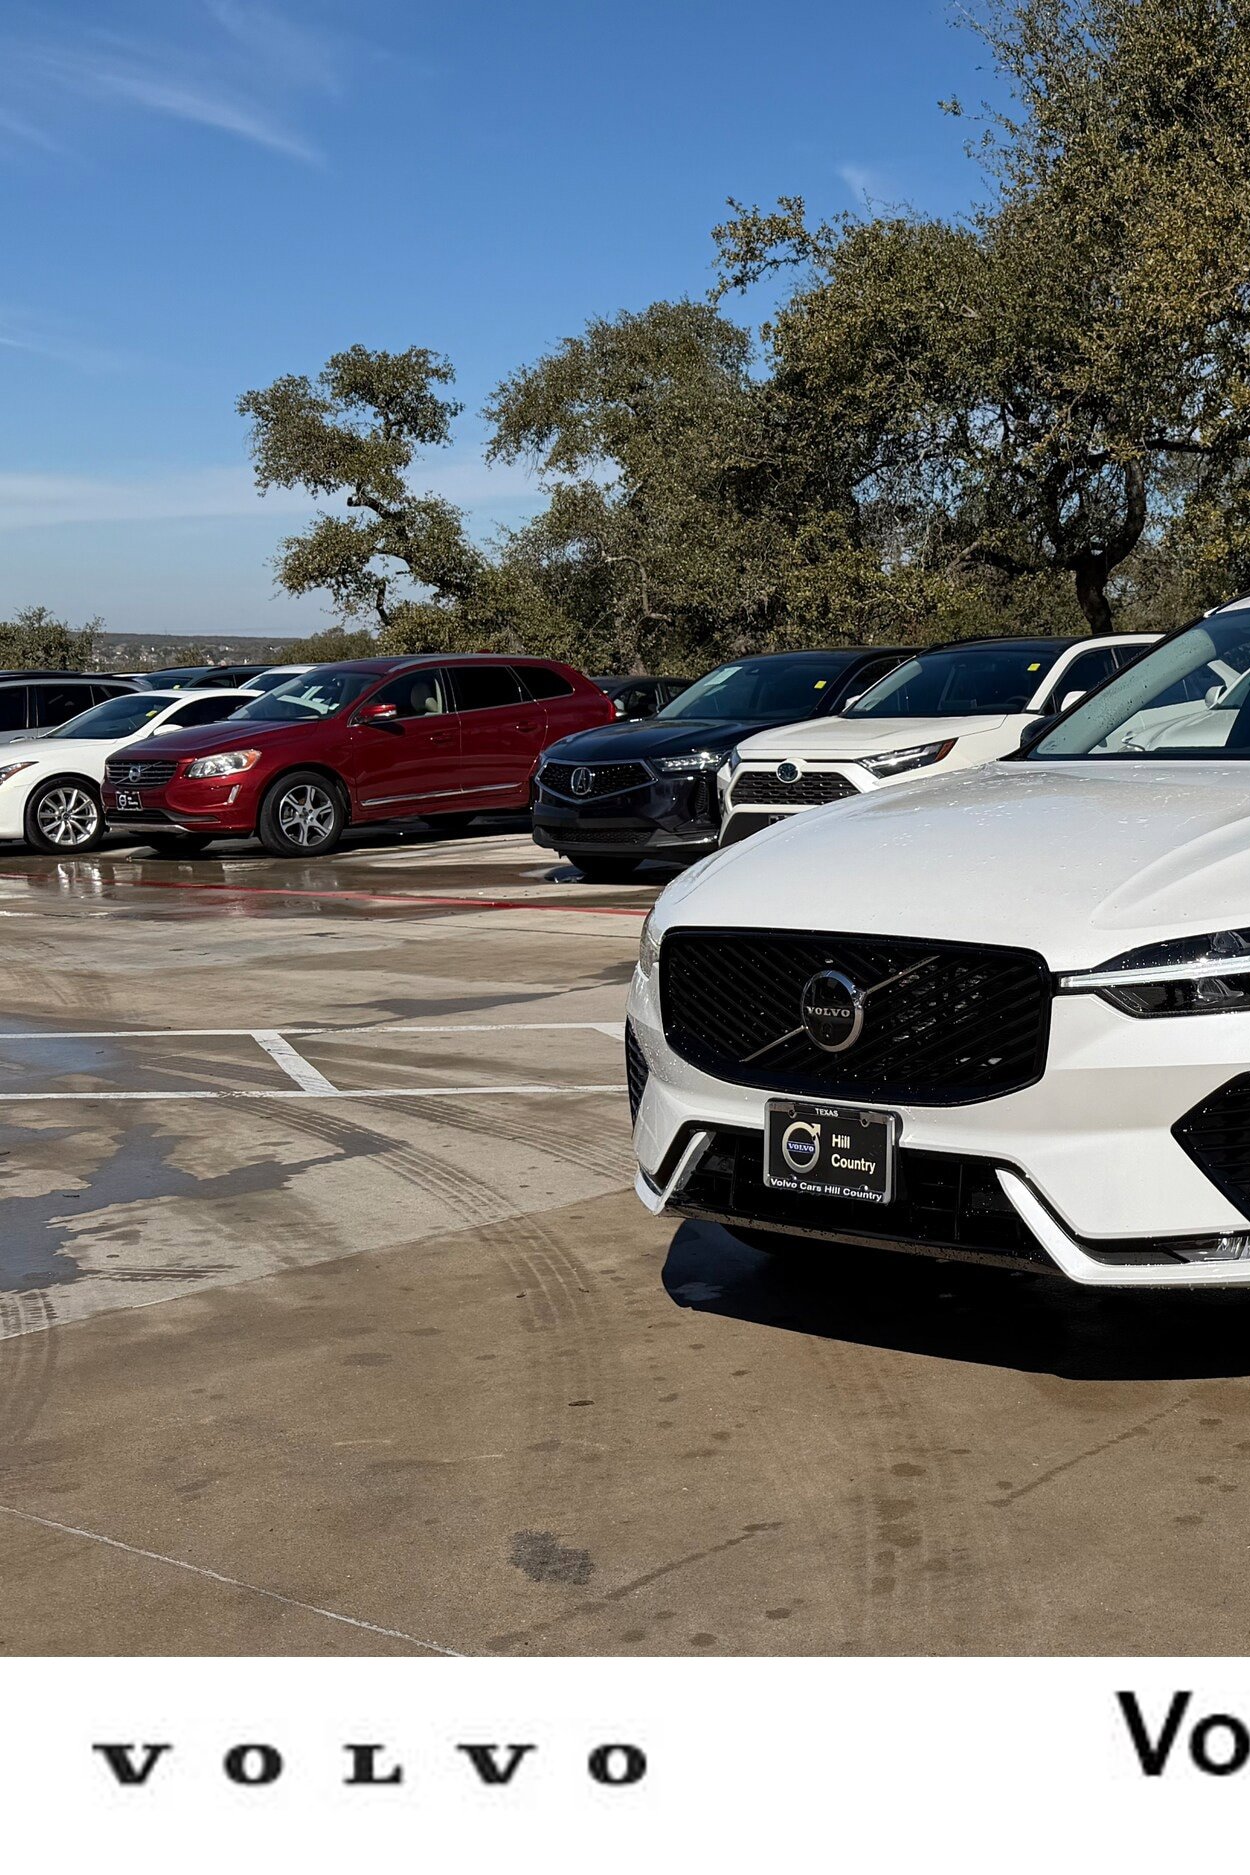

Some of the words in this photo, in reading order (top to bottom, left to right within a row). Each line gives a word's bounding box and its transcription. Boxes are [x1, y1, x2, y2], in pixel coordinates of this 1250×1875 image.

[806, 1005, 851, 1018] VOLVO
[815, 1107, 839, 1118] TEXAS
[787, 1142, 815, 1153] VOLVO
[831, 1133, 851, 1150] Hill
[831, 1153, 876, 1175] Country
[770, 1178, 798, 1189] Volvo
[799, 1181, 822, 1193] Cars
[824, 1185, 841, 1195] Hill
[842, 1188, 883, 1203] Country
